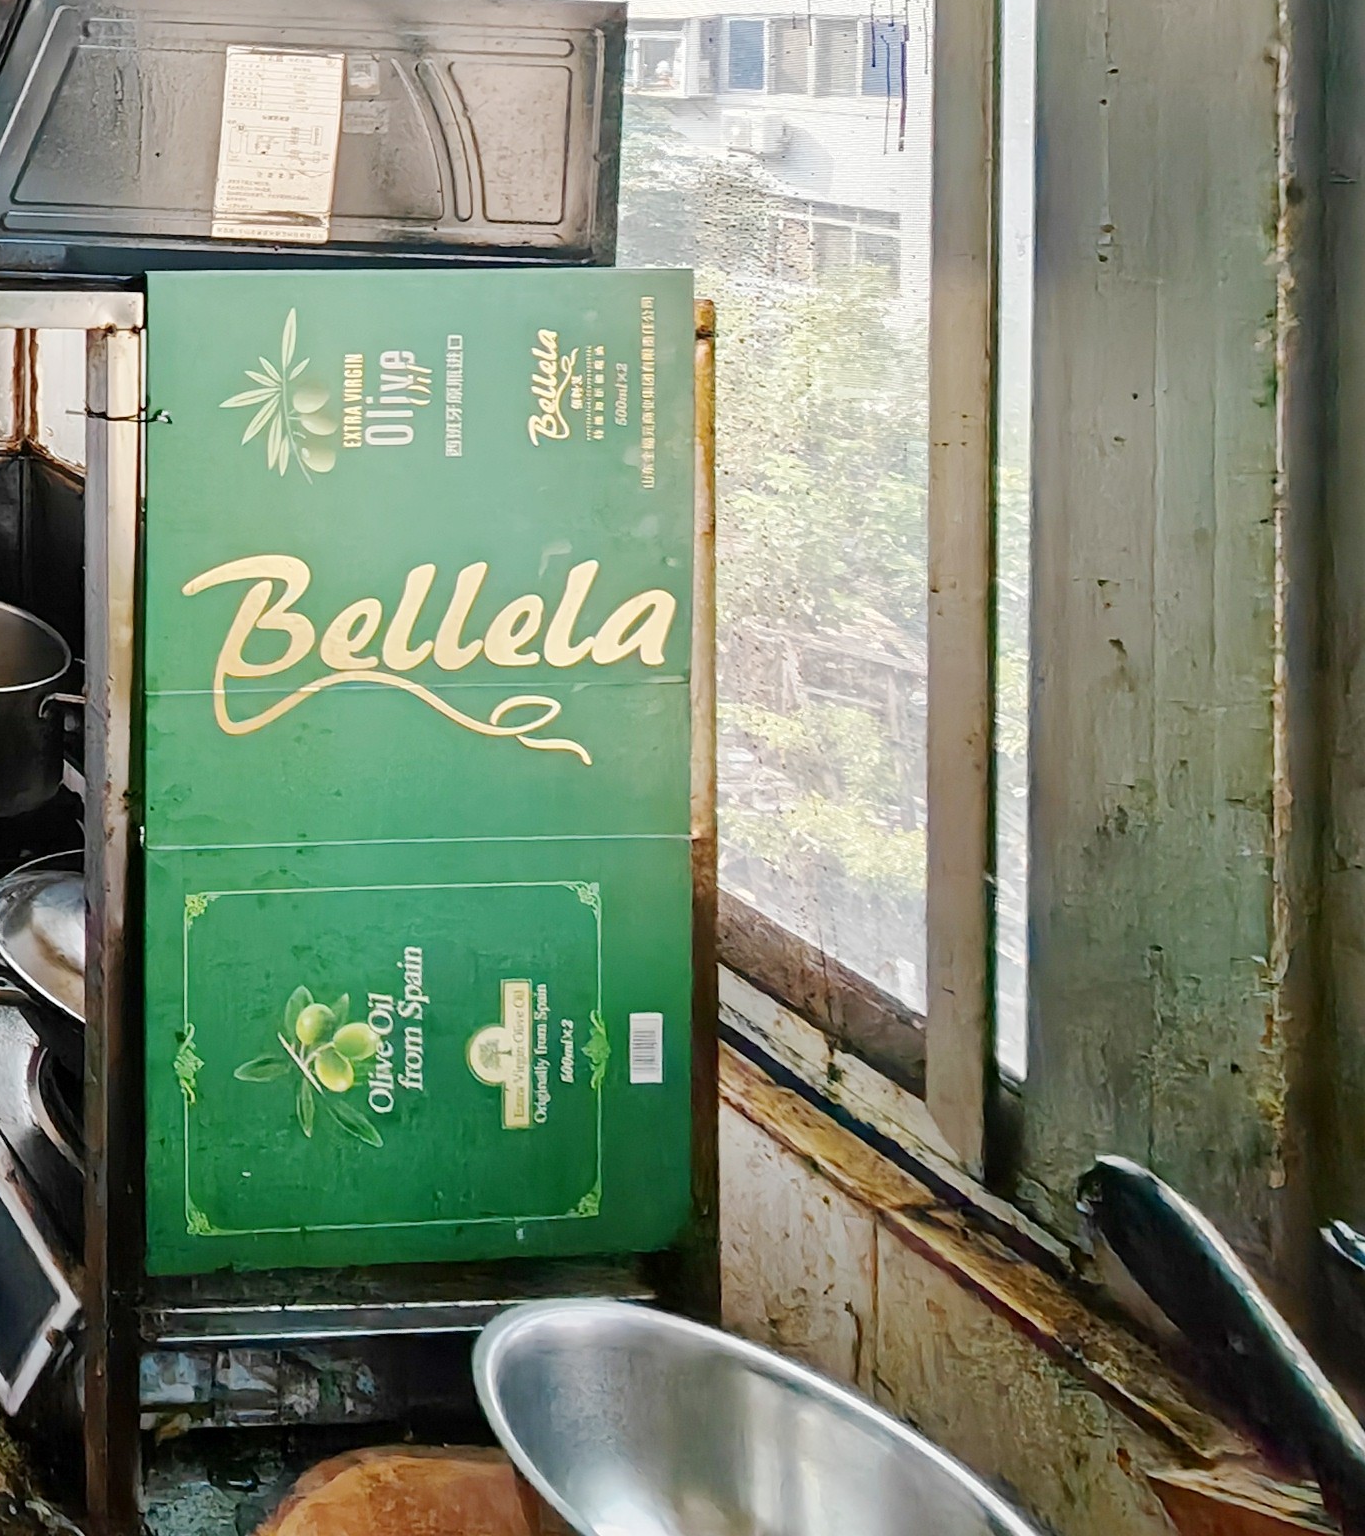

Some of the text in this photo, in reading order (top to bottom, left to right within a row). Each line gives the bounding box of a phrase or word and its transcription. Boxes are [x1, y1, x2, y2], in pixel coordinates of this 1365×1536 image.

[342, 353, 364, 449] EXTRA VIRGIN
[364, 350, 416, 446] Olive
[444, 334, 464, 458] 西班牙原瓶进口
[527, 328, 571, 447] Bellela
[181, 554, 677, 732] Bellela
[367, 992, 395, 1114] Olive Oil
[396, 945, 431, 1092] from Spain
[512, 1010, 526, 1044] Olive
[533, 983, 552, 1124] Originally from Spain
